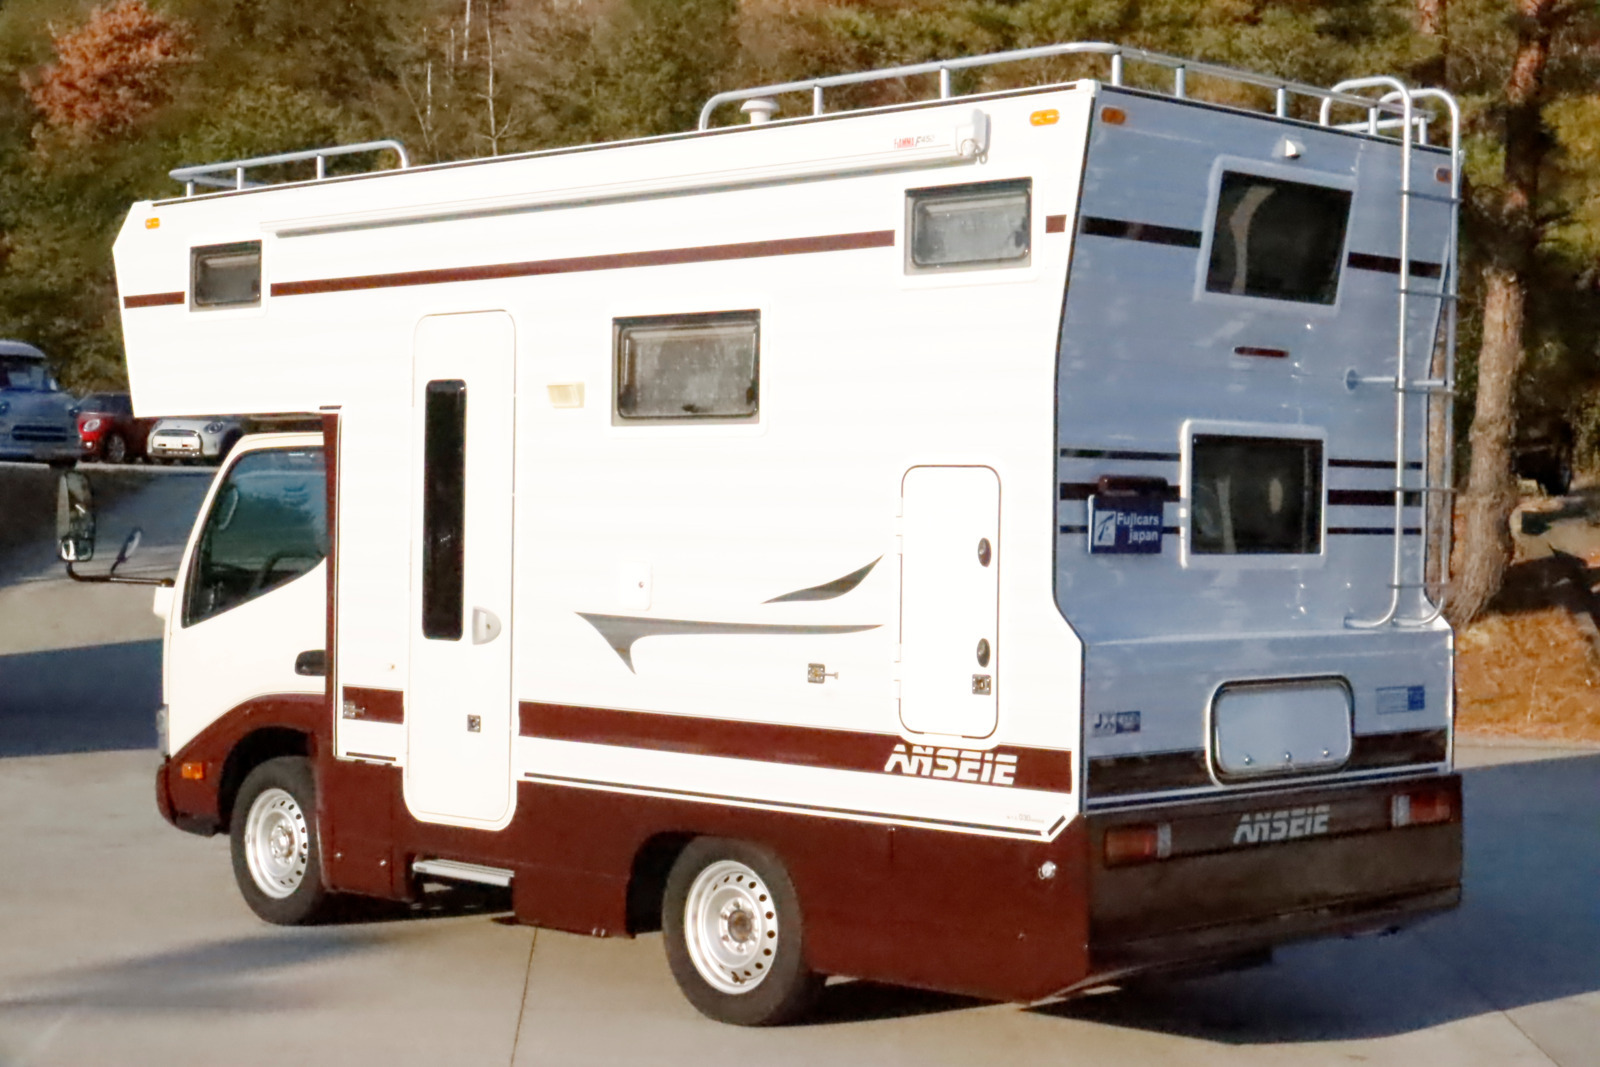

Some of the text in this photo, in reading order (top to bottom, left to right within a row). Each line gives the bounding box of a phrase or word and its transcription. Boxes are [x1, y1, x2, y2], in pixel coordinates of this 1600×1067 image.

[1116, 512, 1159, 528] Fujicars
[1128, 528, 1158, 544] japan
[884, 743, 1018, 785] ANSEIE
[1233, 804, 1330, 844] ANSEIE
